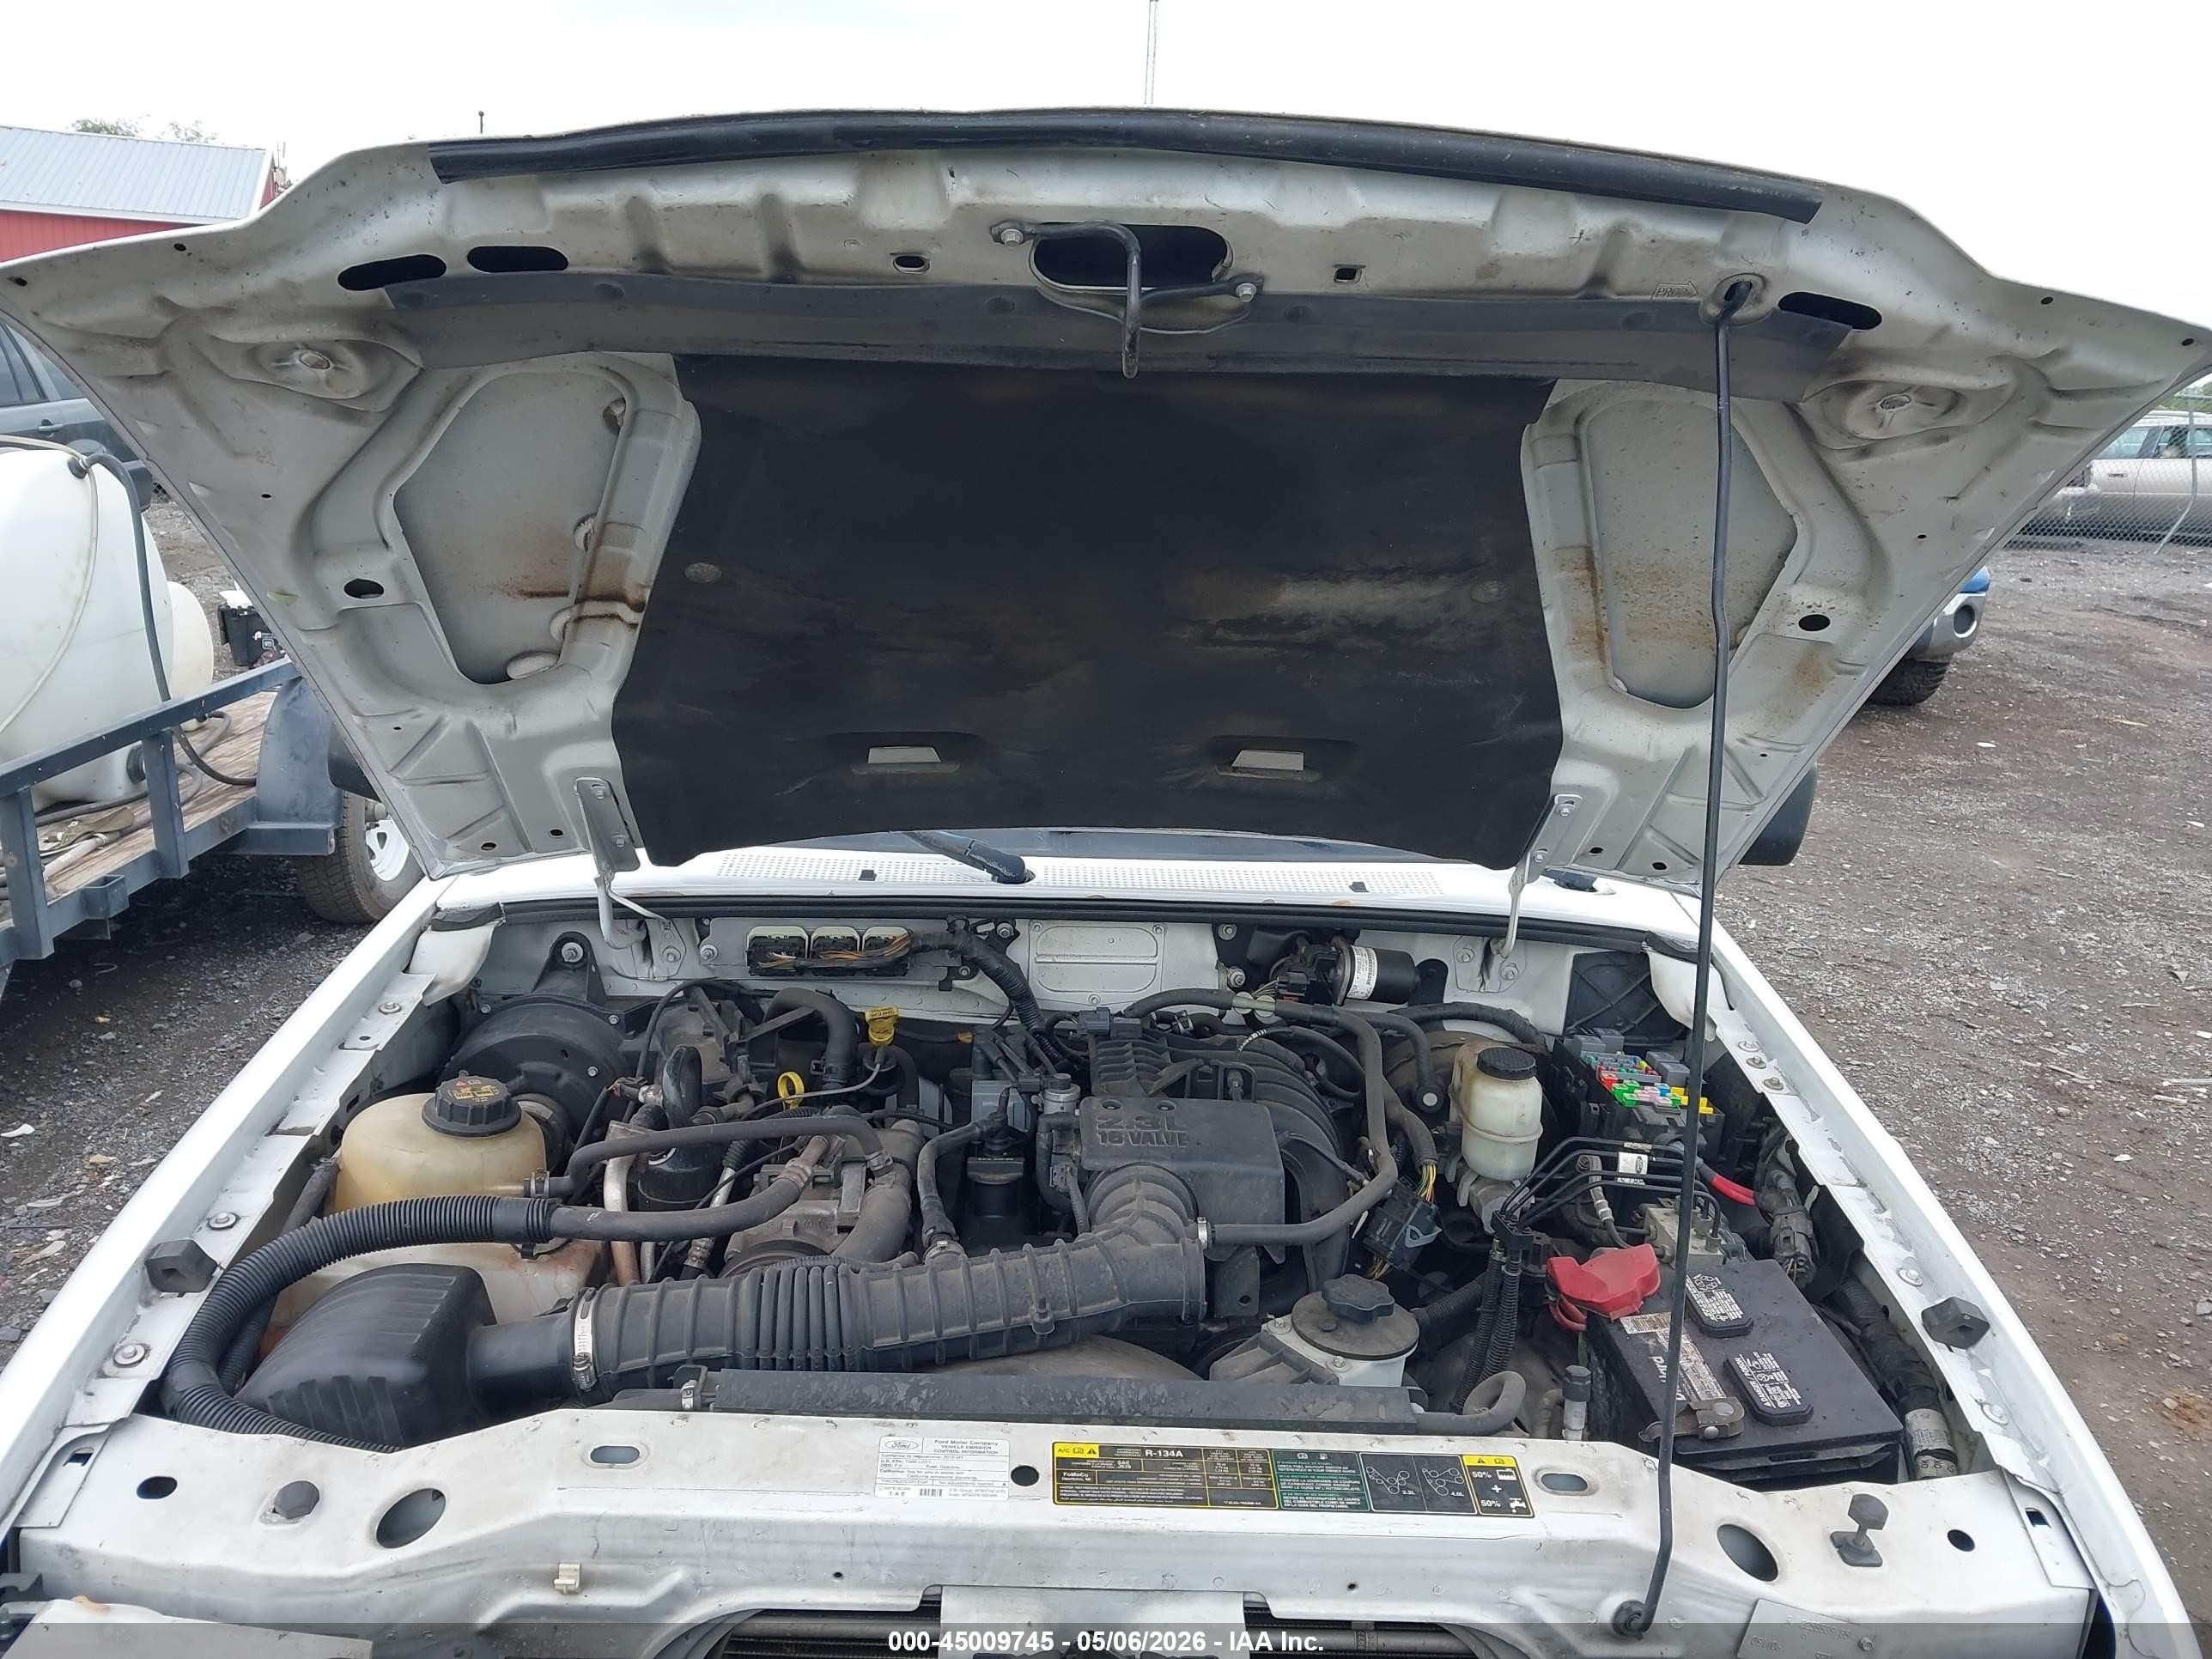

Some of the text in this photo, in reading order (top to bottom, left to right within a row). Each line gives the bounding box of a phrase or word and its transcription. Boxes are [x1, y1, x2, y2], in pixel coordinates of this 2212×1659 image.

[1098, 1132, 1188, 1148] 16 VALVE
[1734, 1357, 1753, 1376] POISON
[1750, 1380, 1768, 1404] DANGER
[1145, 1449, 1184, 1458] R-134A
